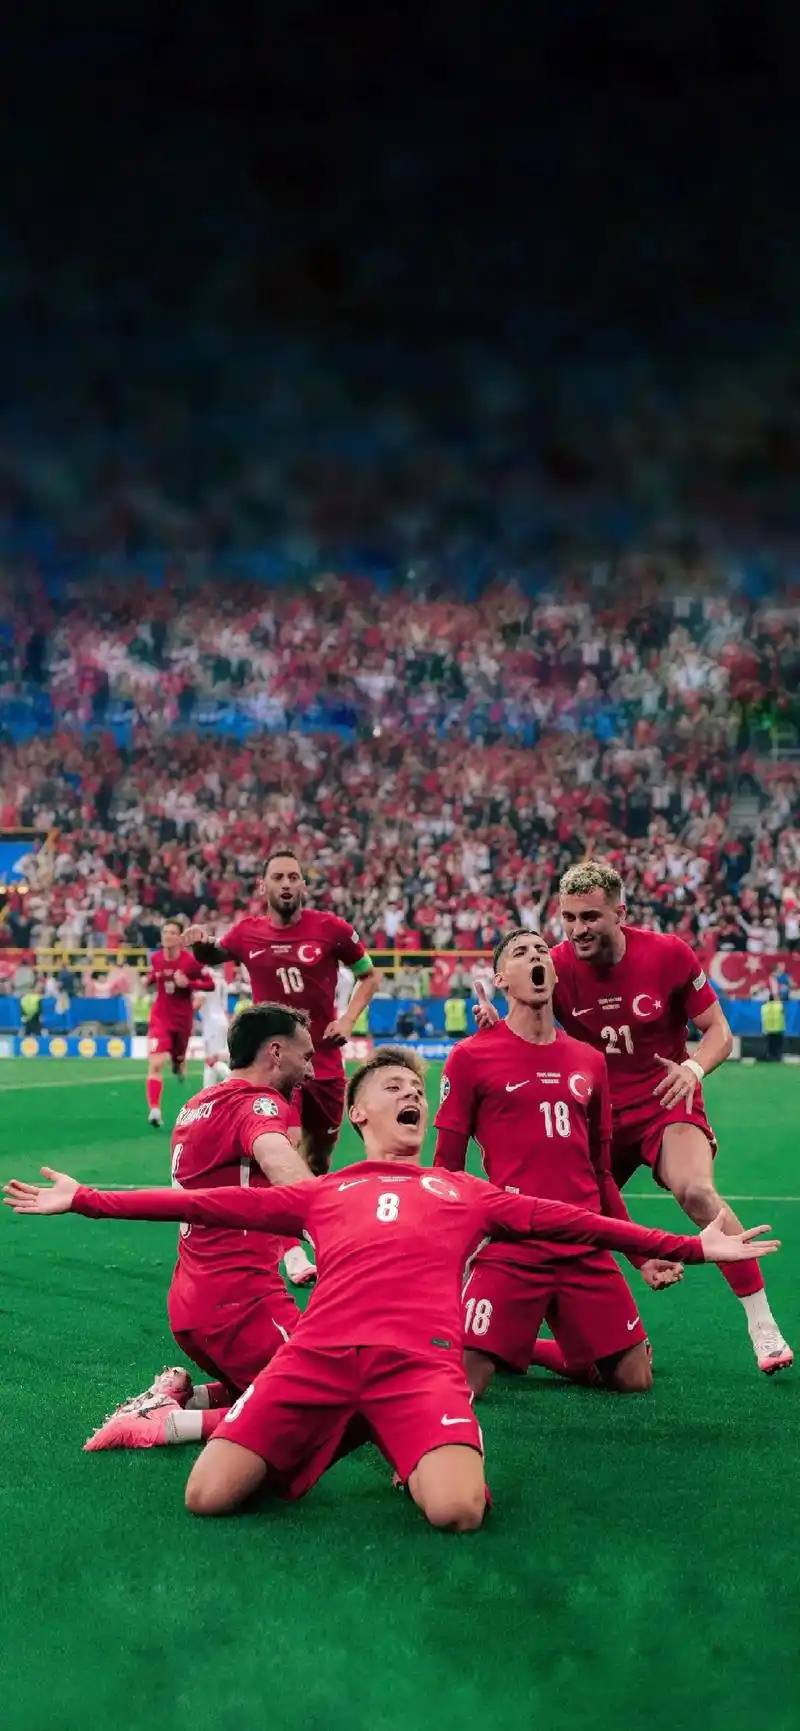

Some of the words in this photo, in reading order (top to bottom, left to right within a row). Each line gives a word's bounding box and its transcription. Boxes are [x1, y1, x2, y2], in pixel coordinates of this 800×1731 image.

[276, 966, 305, 994] 10
[601, 1025, 634, 1054] 21
[540, 1101, 571, 1137] 18
[376, 1193, 400, 1222] 8
[464, 1298, 493, 1336] 18
